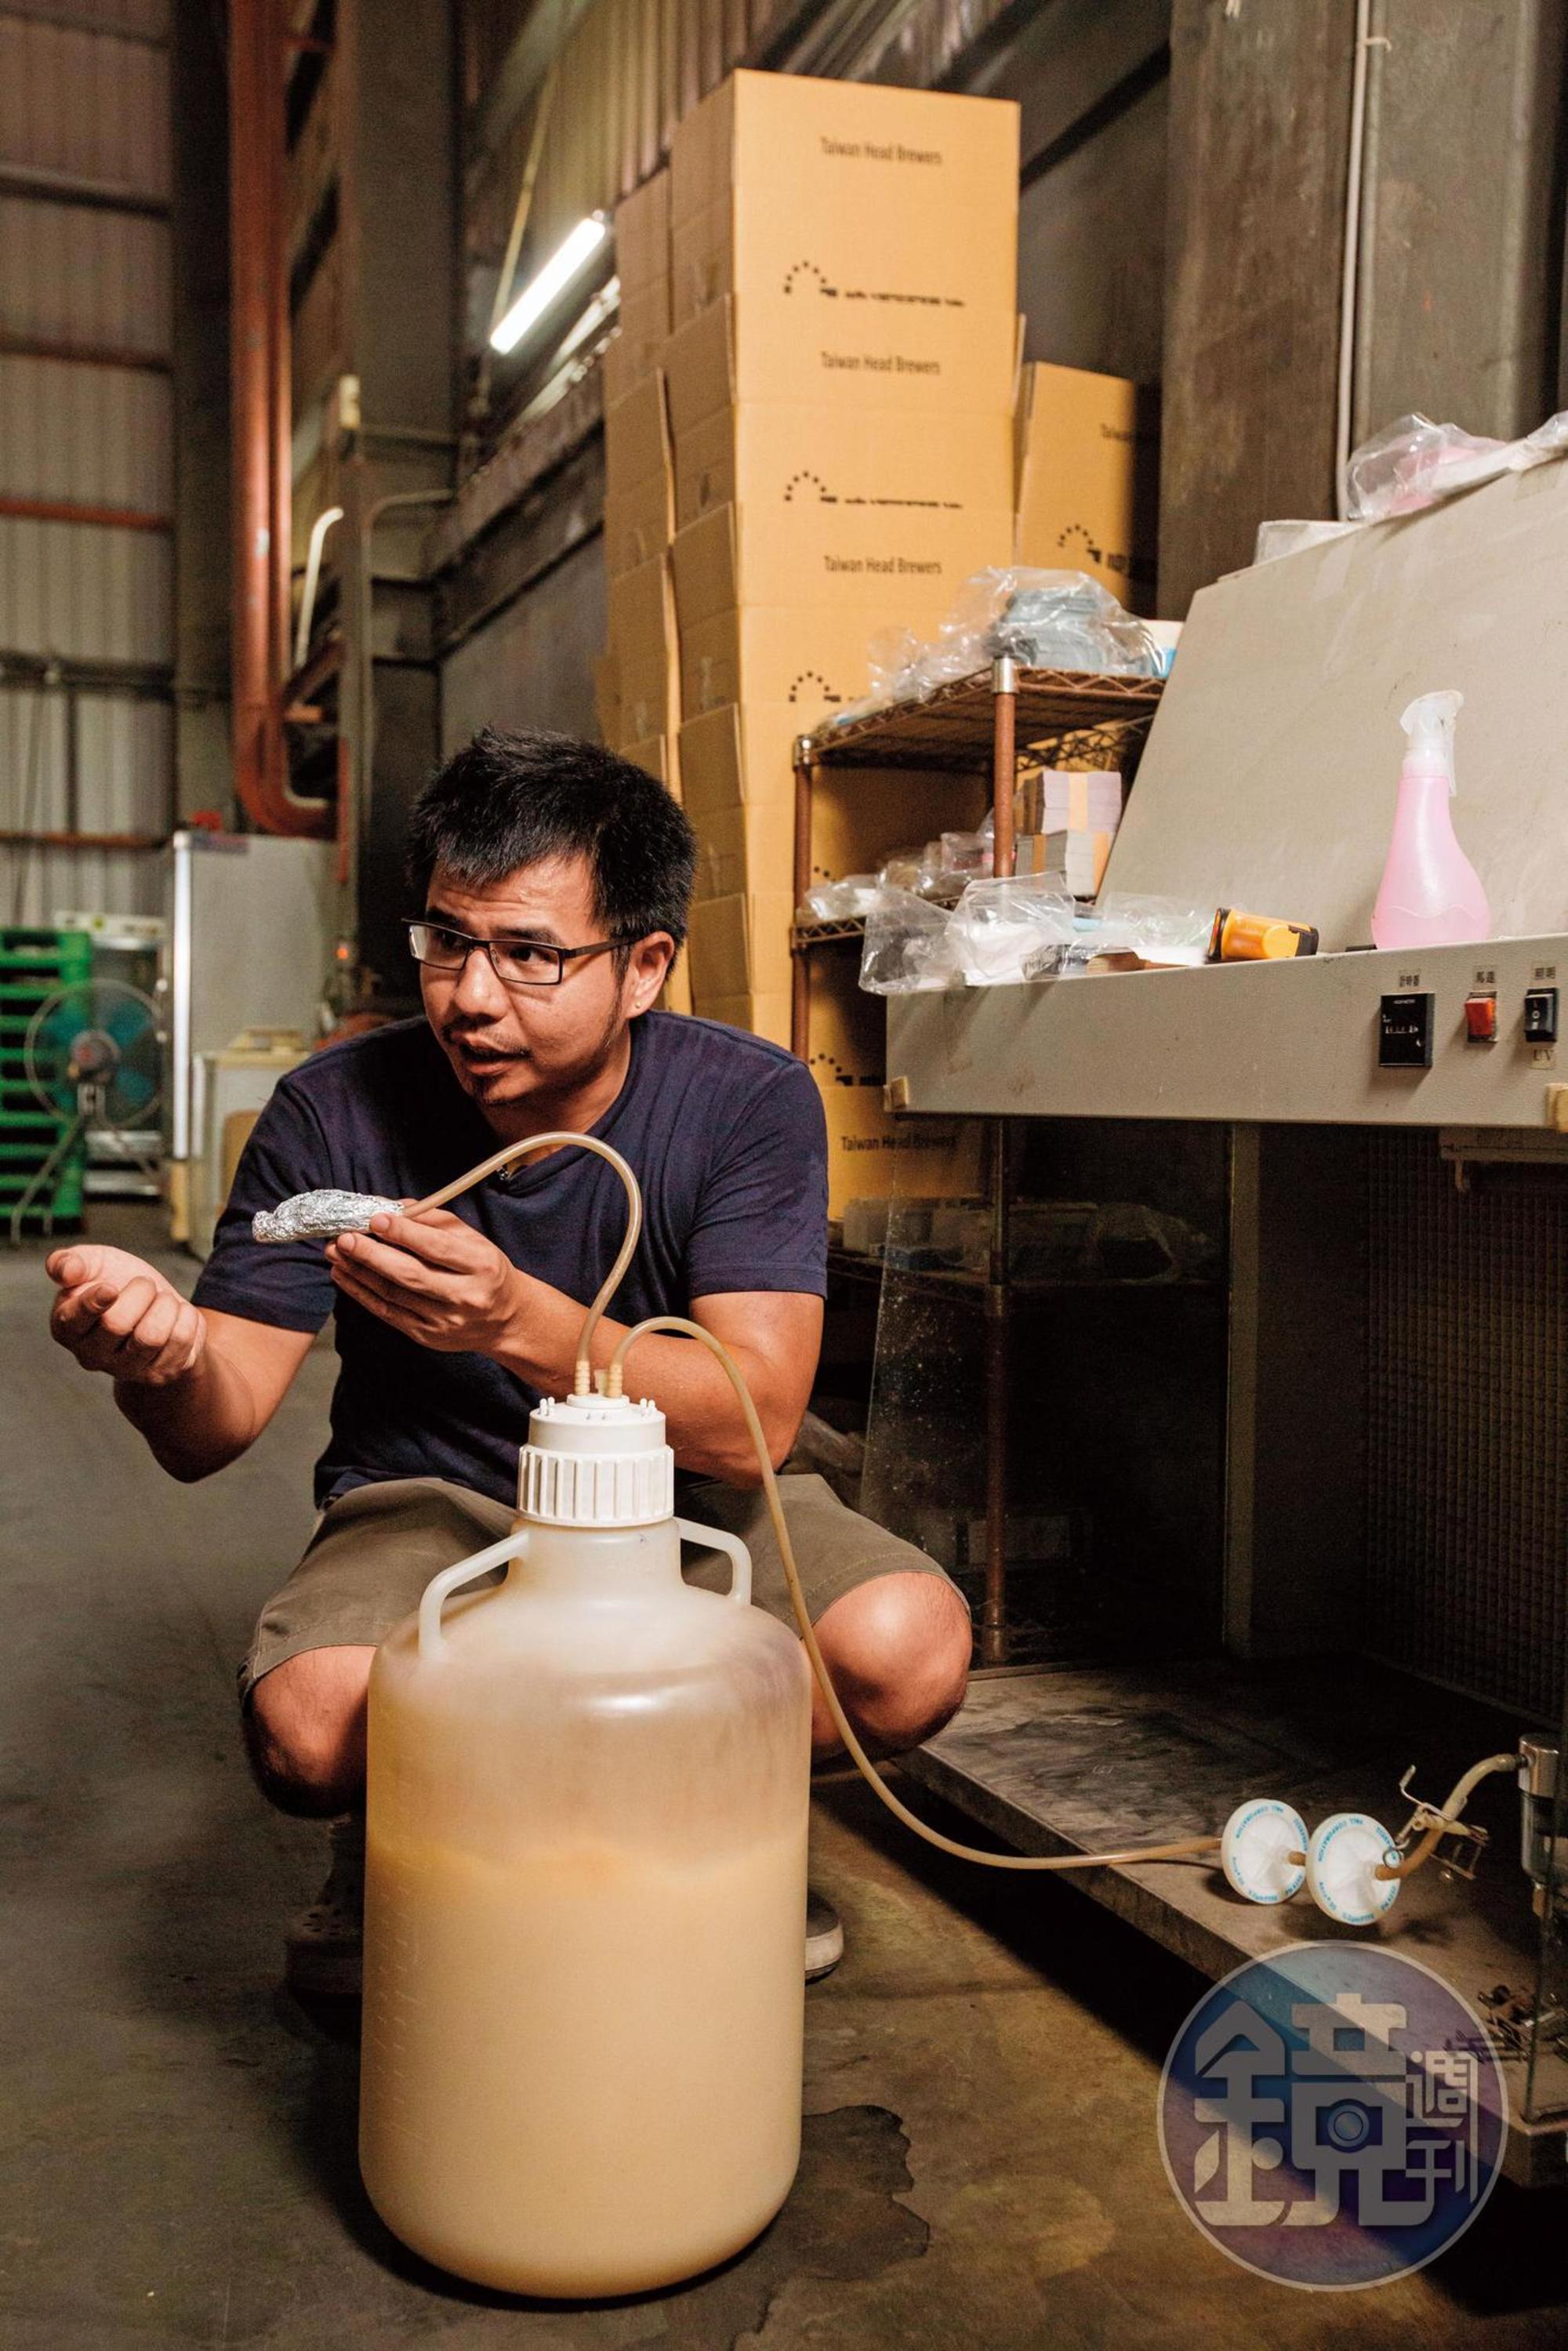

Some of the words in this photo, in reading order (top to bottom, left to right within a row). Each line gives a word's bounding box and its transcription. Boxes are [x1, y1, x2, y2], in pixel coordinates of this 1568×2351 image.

[821, 136, 859, 157] Taiwan
[864, 141, 893, 161] Head
[898, 143, 942, 166] Brewers
[821, 351, 859, 369] Taiwan
[863, 354, 892, 372] Head
[895, 355, 939, 376] Brewers
[824, 555, 862, 572] Taiwan
[866, 557, 895, 574] Head
[898, 557, 942, 575] Brewers
[841, 1135, 879, 1151] Taiwan
[882, 1135, 909, 1150] Head
